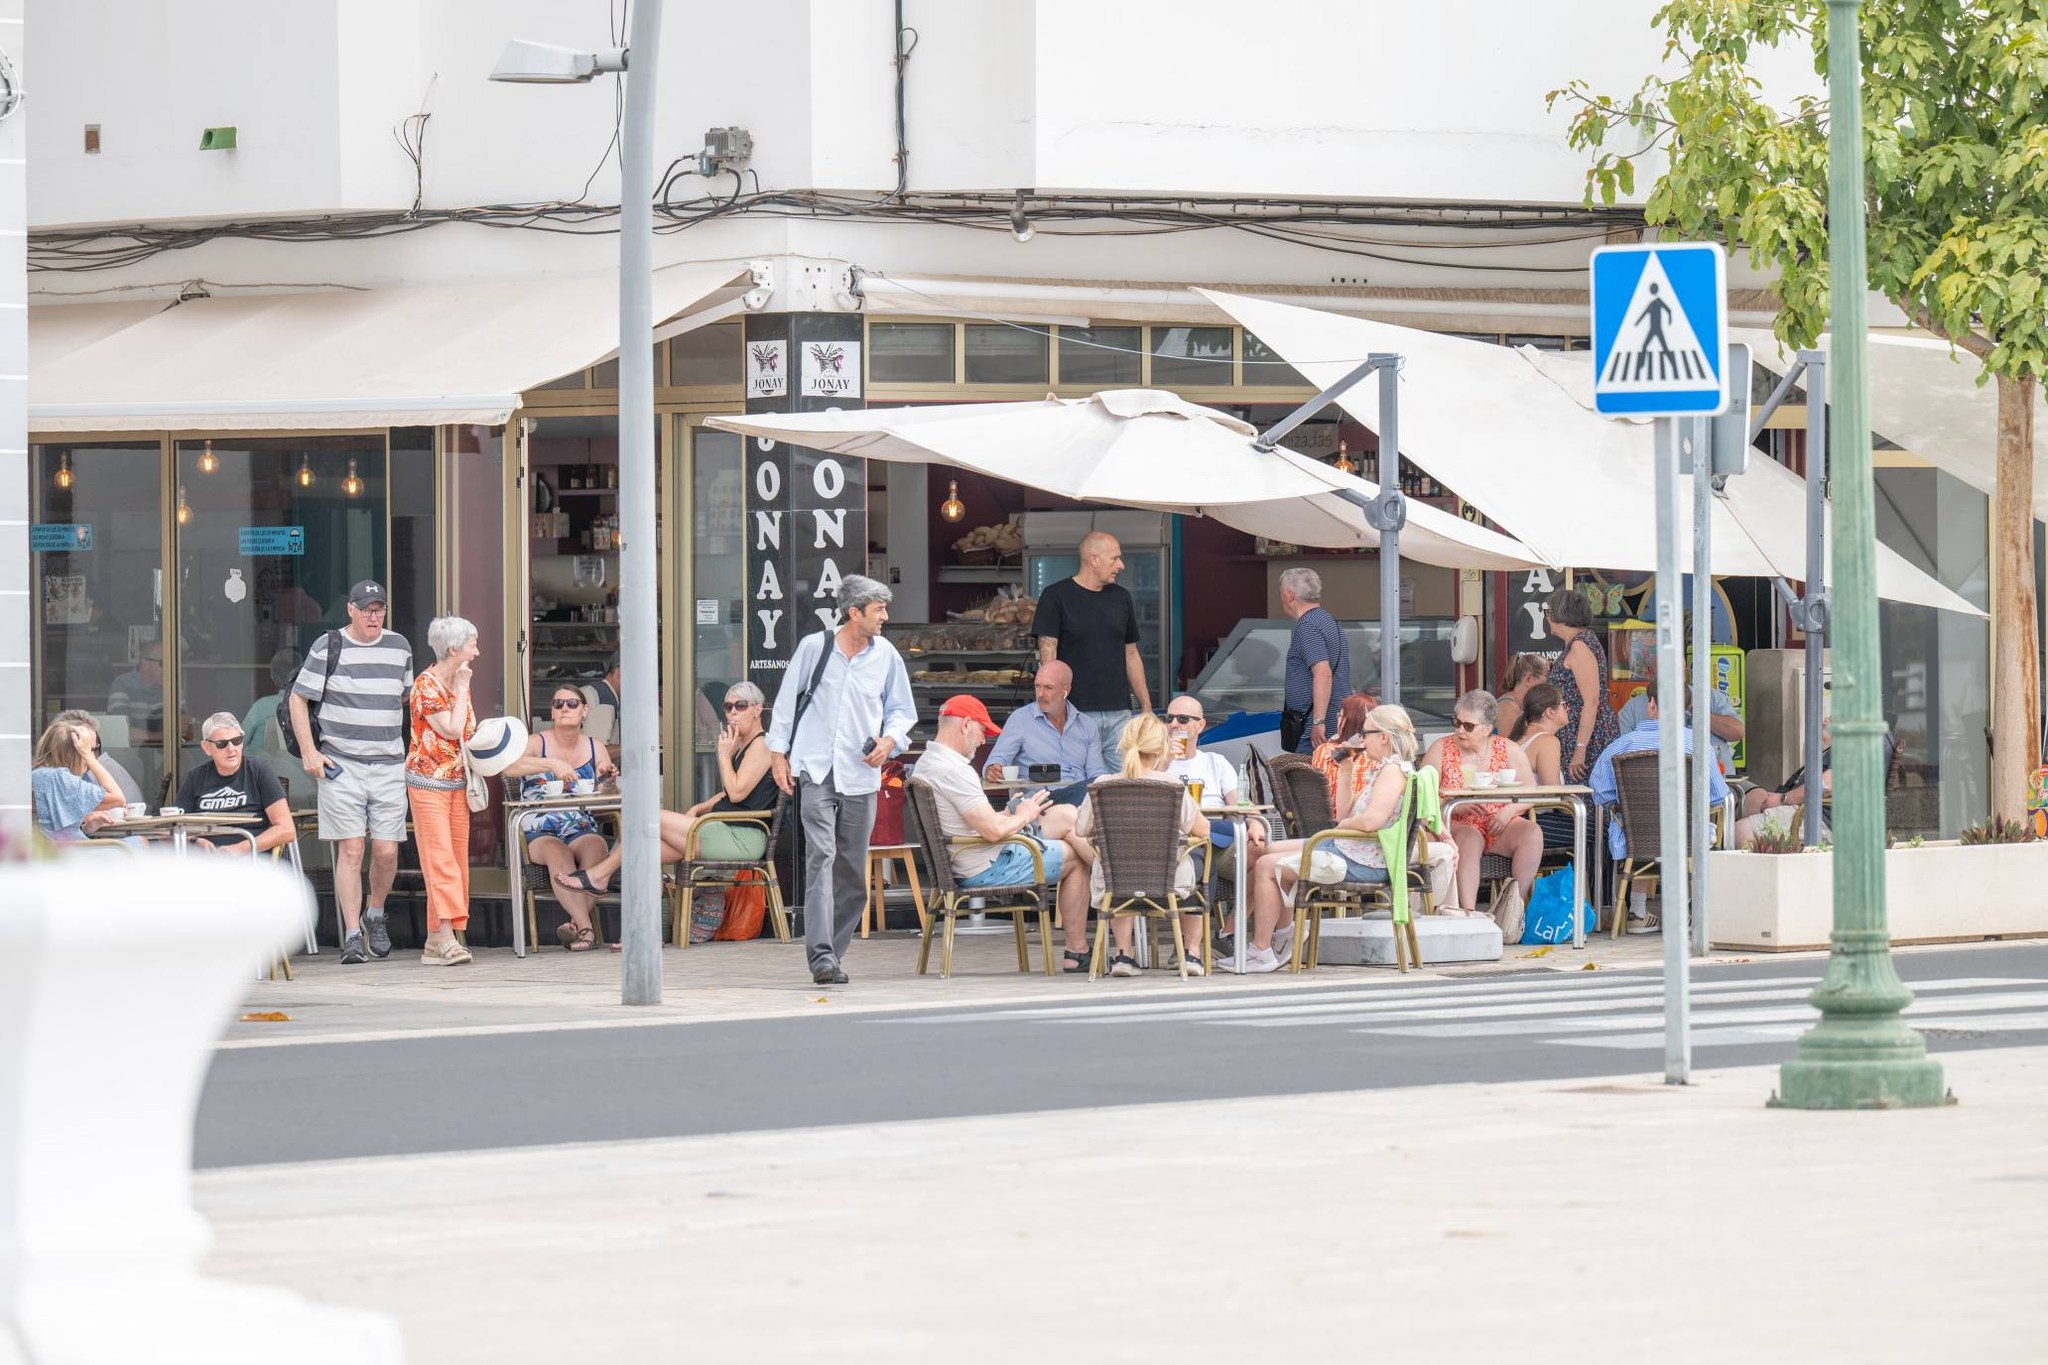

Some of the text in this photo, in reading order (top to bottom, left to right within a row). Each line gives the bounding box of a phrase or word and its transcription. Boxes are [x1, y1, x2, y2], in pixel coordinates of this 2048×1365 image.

[753, 378, 784, 390] JONAY
[811, 379, 850, 390] JONAY
[750, 659, 790, 669] ARTESANOS
[199, 794, 248, 810] GMBN
